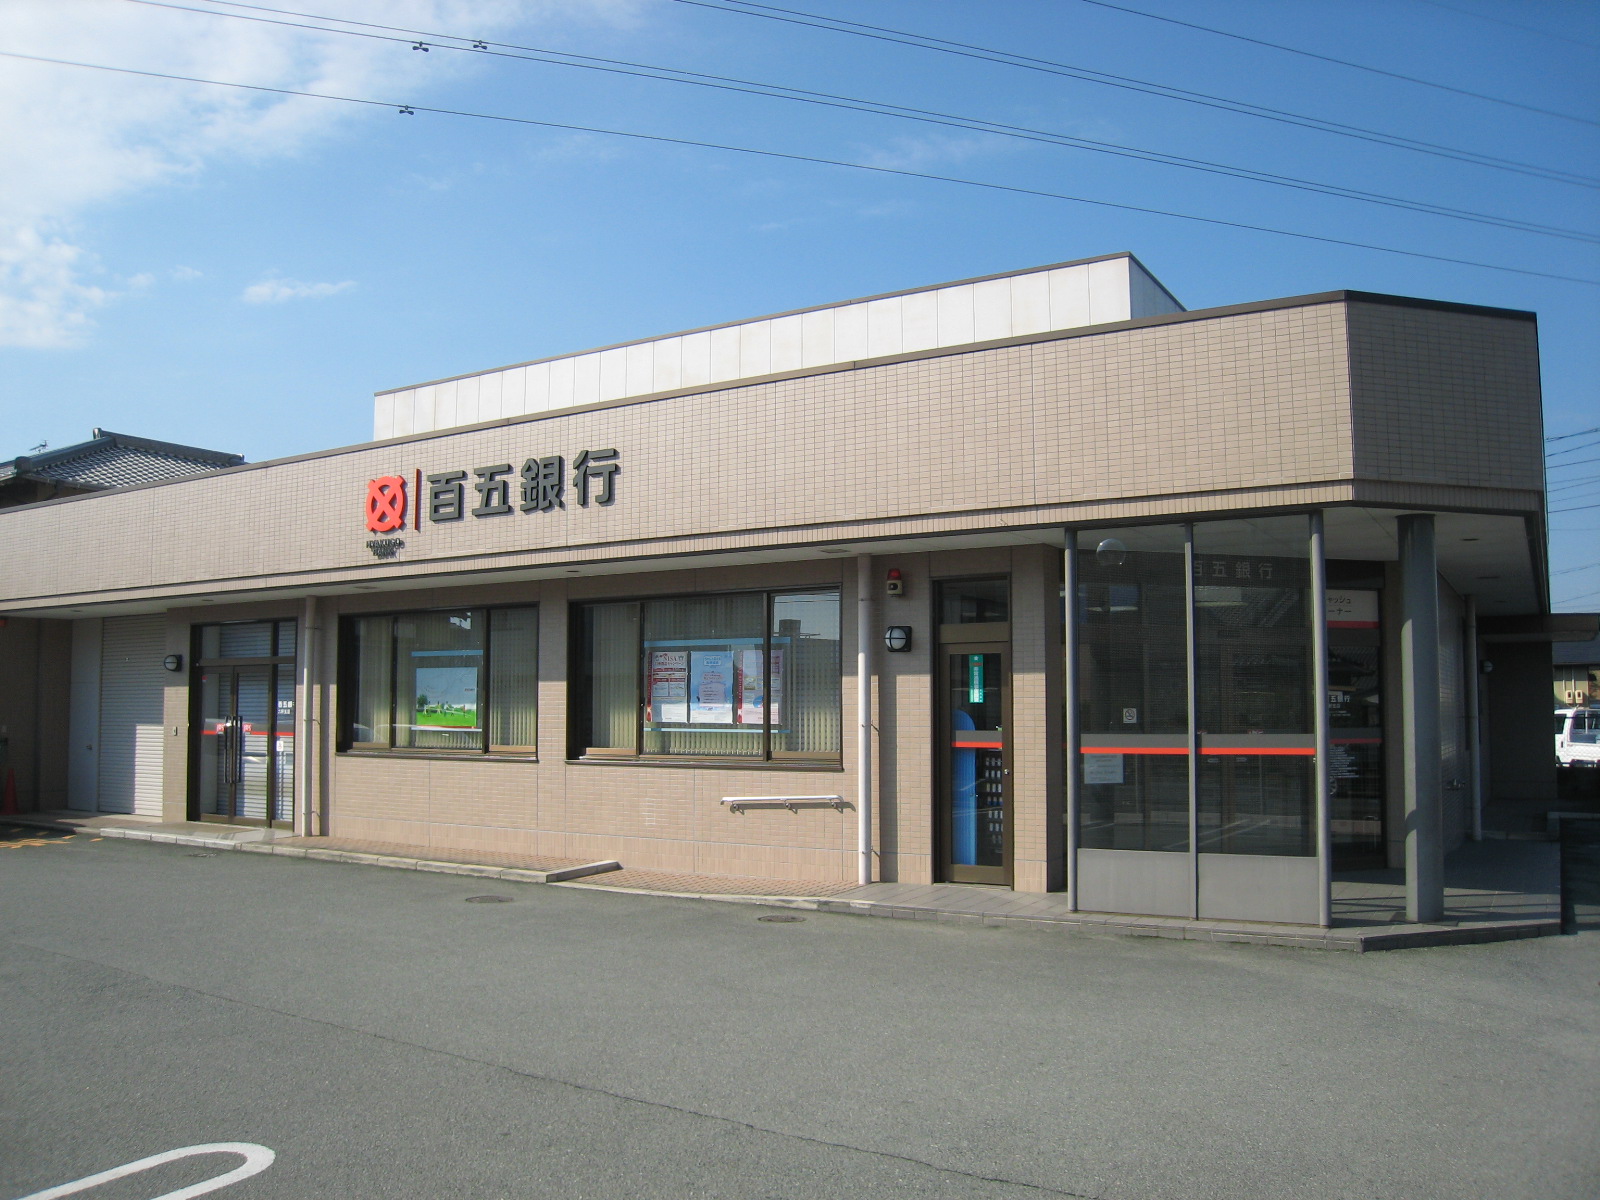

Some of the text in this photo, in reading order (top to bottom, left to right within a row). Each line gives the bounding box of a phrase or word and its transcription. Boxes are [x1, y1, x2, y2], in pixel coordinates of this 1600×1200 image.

[427, 448, 619, 522] 百五銀行
[366, 538, 401, 549] HYAKUGO
[1327, 595, 1352, 605] ャッシュ
[1327, 607, 1352, 616] ーナー
